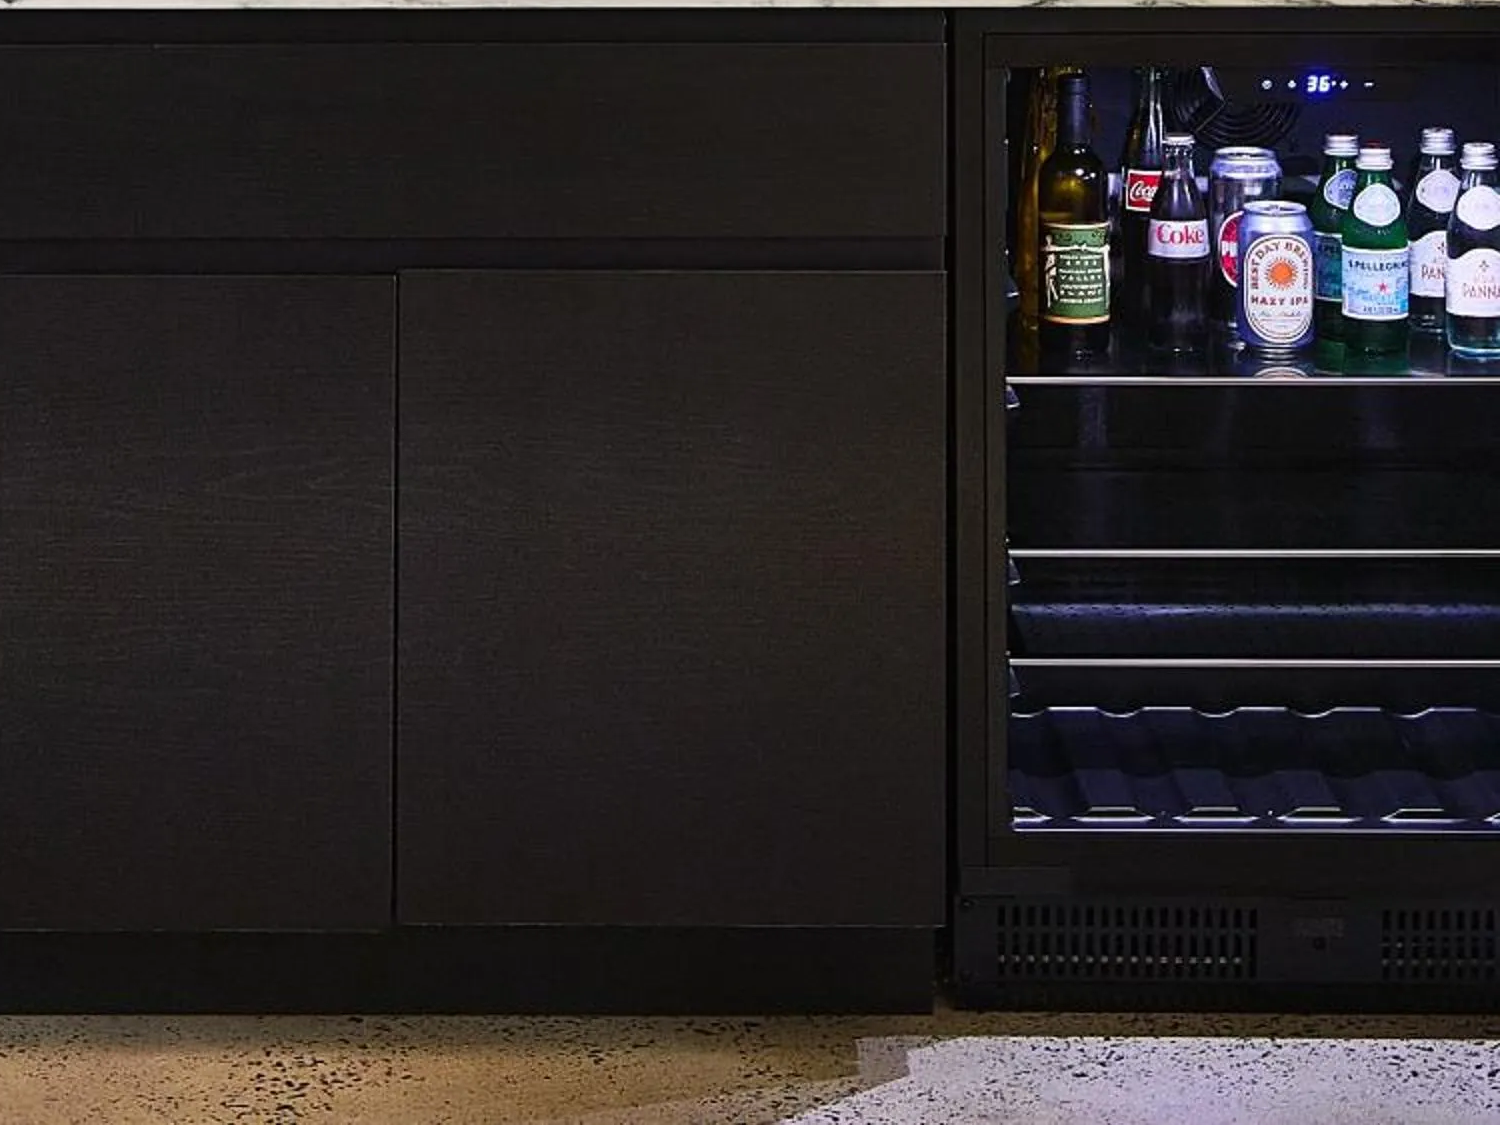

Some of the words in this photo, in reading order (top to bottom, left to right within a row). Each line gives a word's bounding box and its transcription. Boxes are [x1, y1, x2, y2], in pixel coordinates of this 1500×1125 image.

[1307, 75, 1330, 92] 36
[1156, 222, 1205, 245] Coke
[1255, 240, 1280, 260] DAY
[1421, 262, 1445, 280] PAN
[1251, 295, 1285, 306] HAZY
[1290, 295, 1309, 306] IPA
